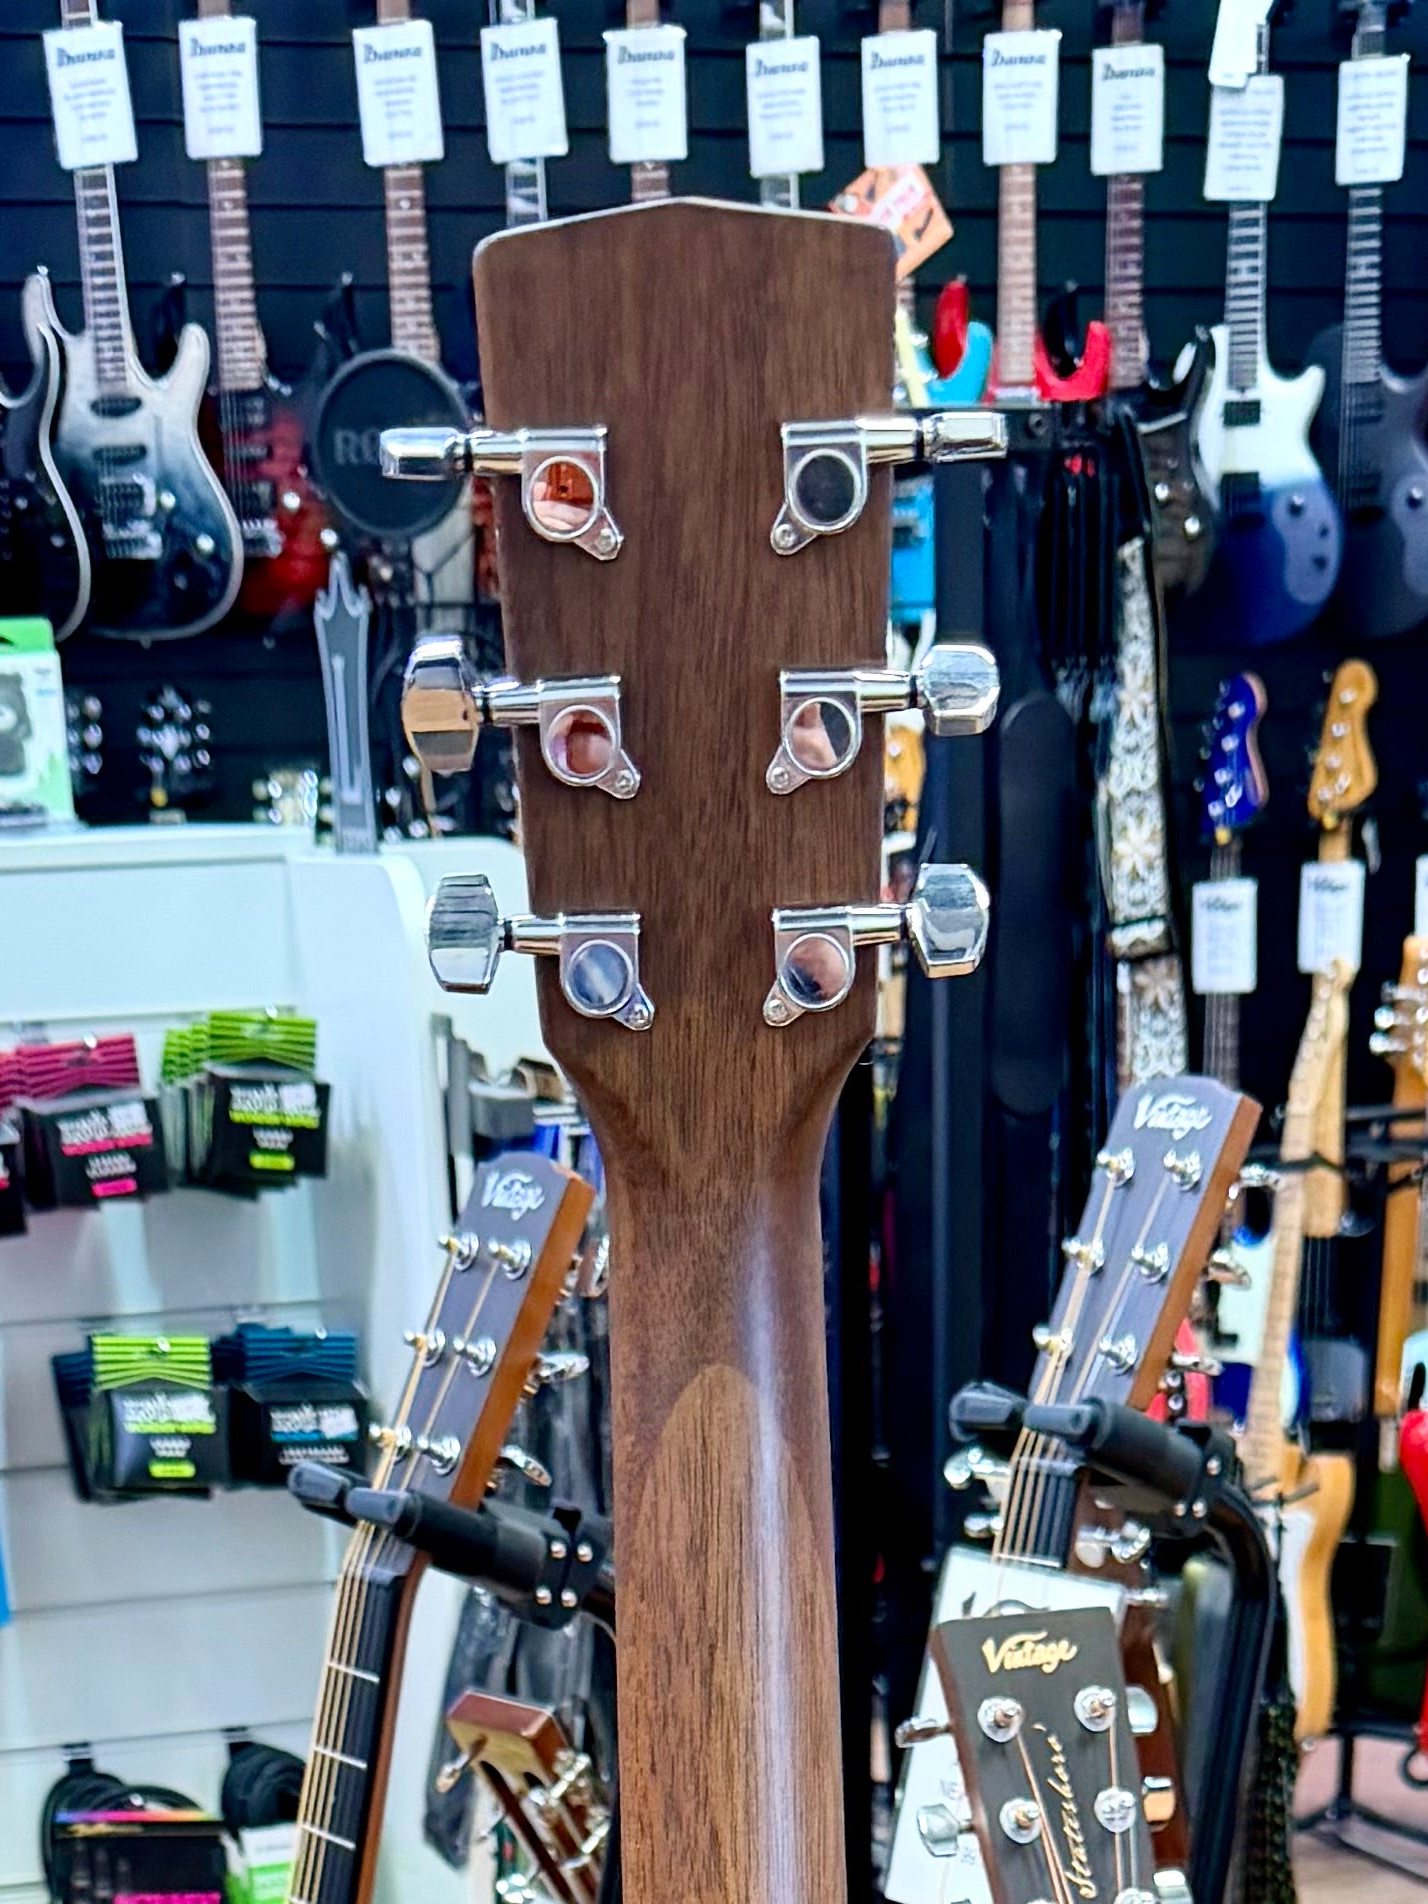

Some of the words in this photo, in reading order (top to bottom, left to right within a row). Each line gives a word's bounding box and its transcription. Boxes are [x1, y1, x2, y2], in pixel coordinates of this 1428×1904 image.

[1134, 1094, 1212, 1140] Vintage
[481, 1173, 545, 1220] Vintage
[982, 1630, 1077, 1672] Vintage
